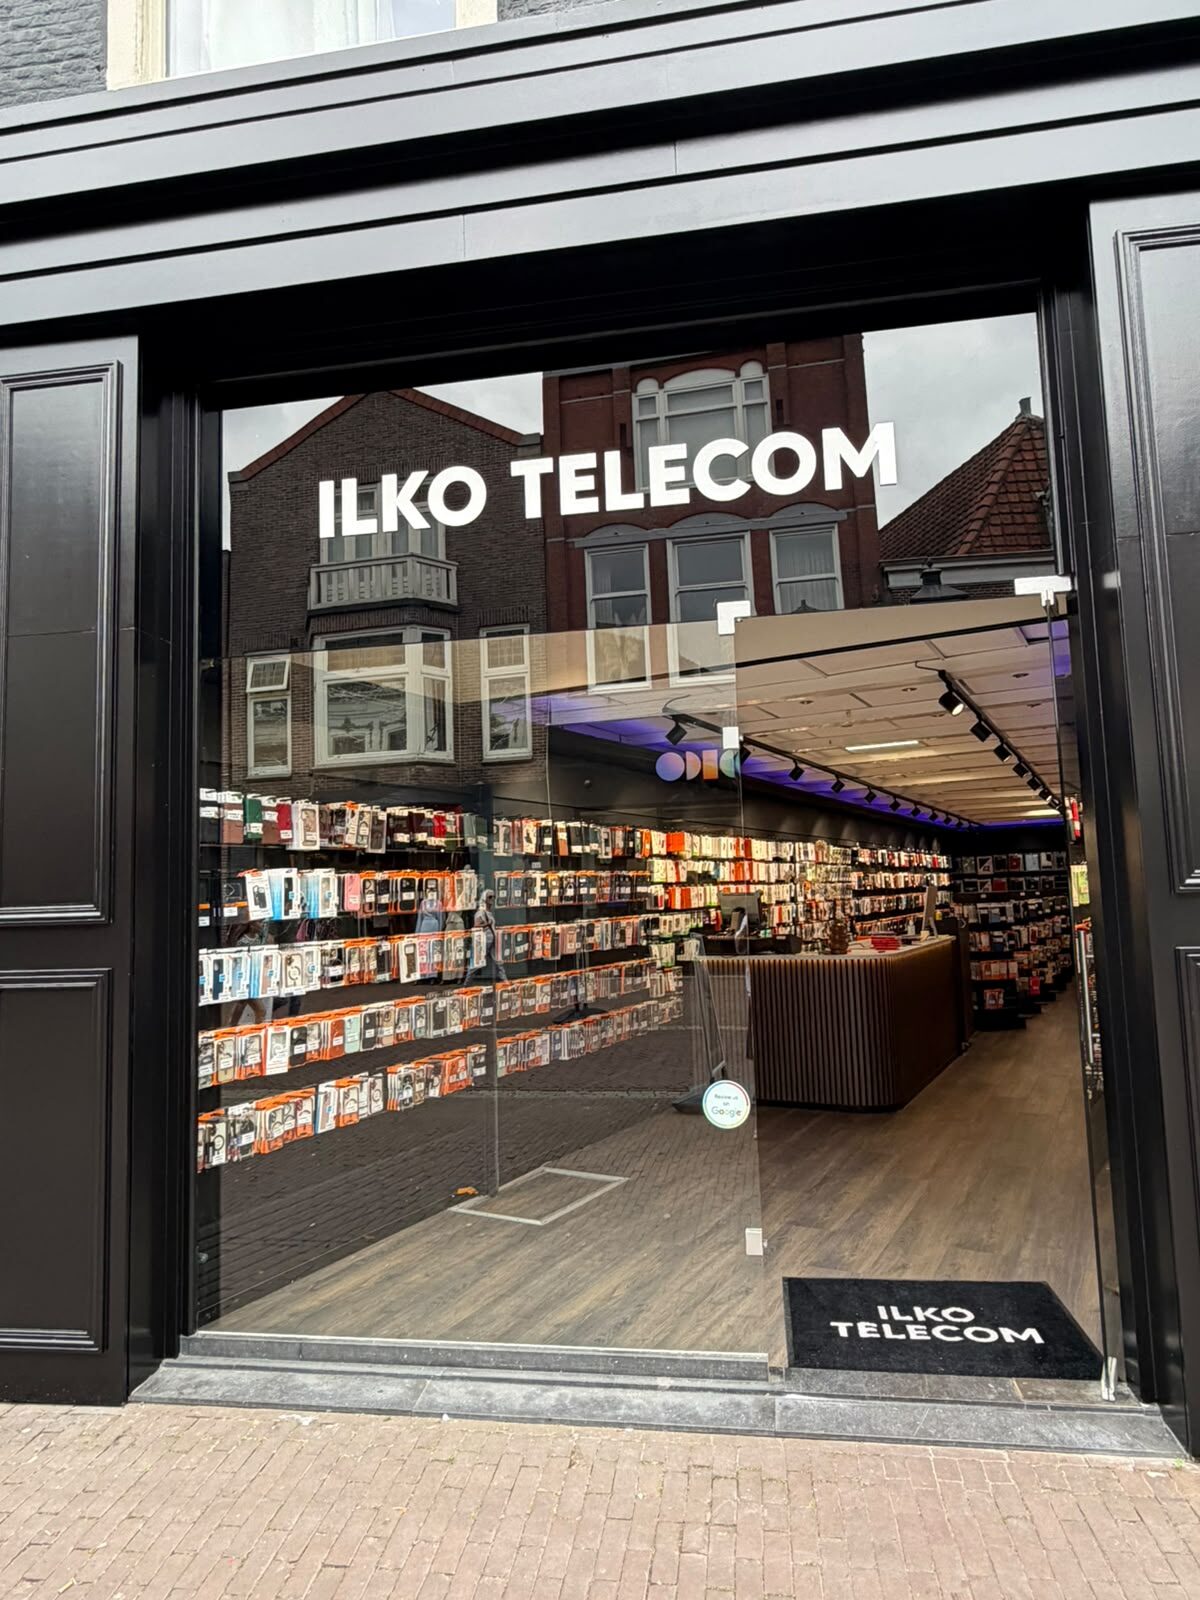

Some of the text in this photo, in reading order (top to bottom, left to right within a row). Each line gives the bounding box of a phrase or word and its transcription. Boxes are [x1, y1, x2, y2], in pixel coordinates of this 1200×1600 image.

[319, 421, 898, 539] ILKO TELECOM
[877, 1305, 975, 1322] ILKO
[829, 1321, 1045, 1344] TELECOM
